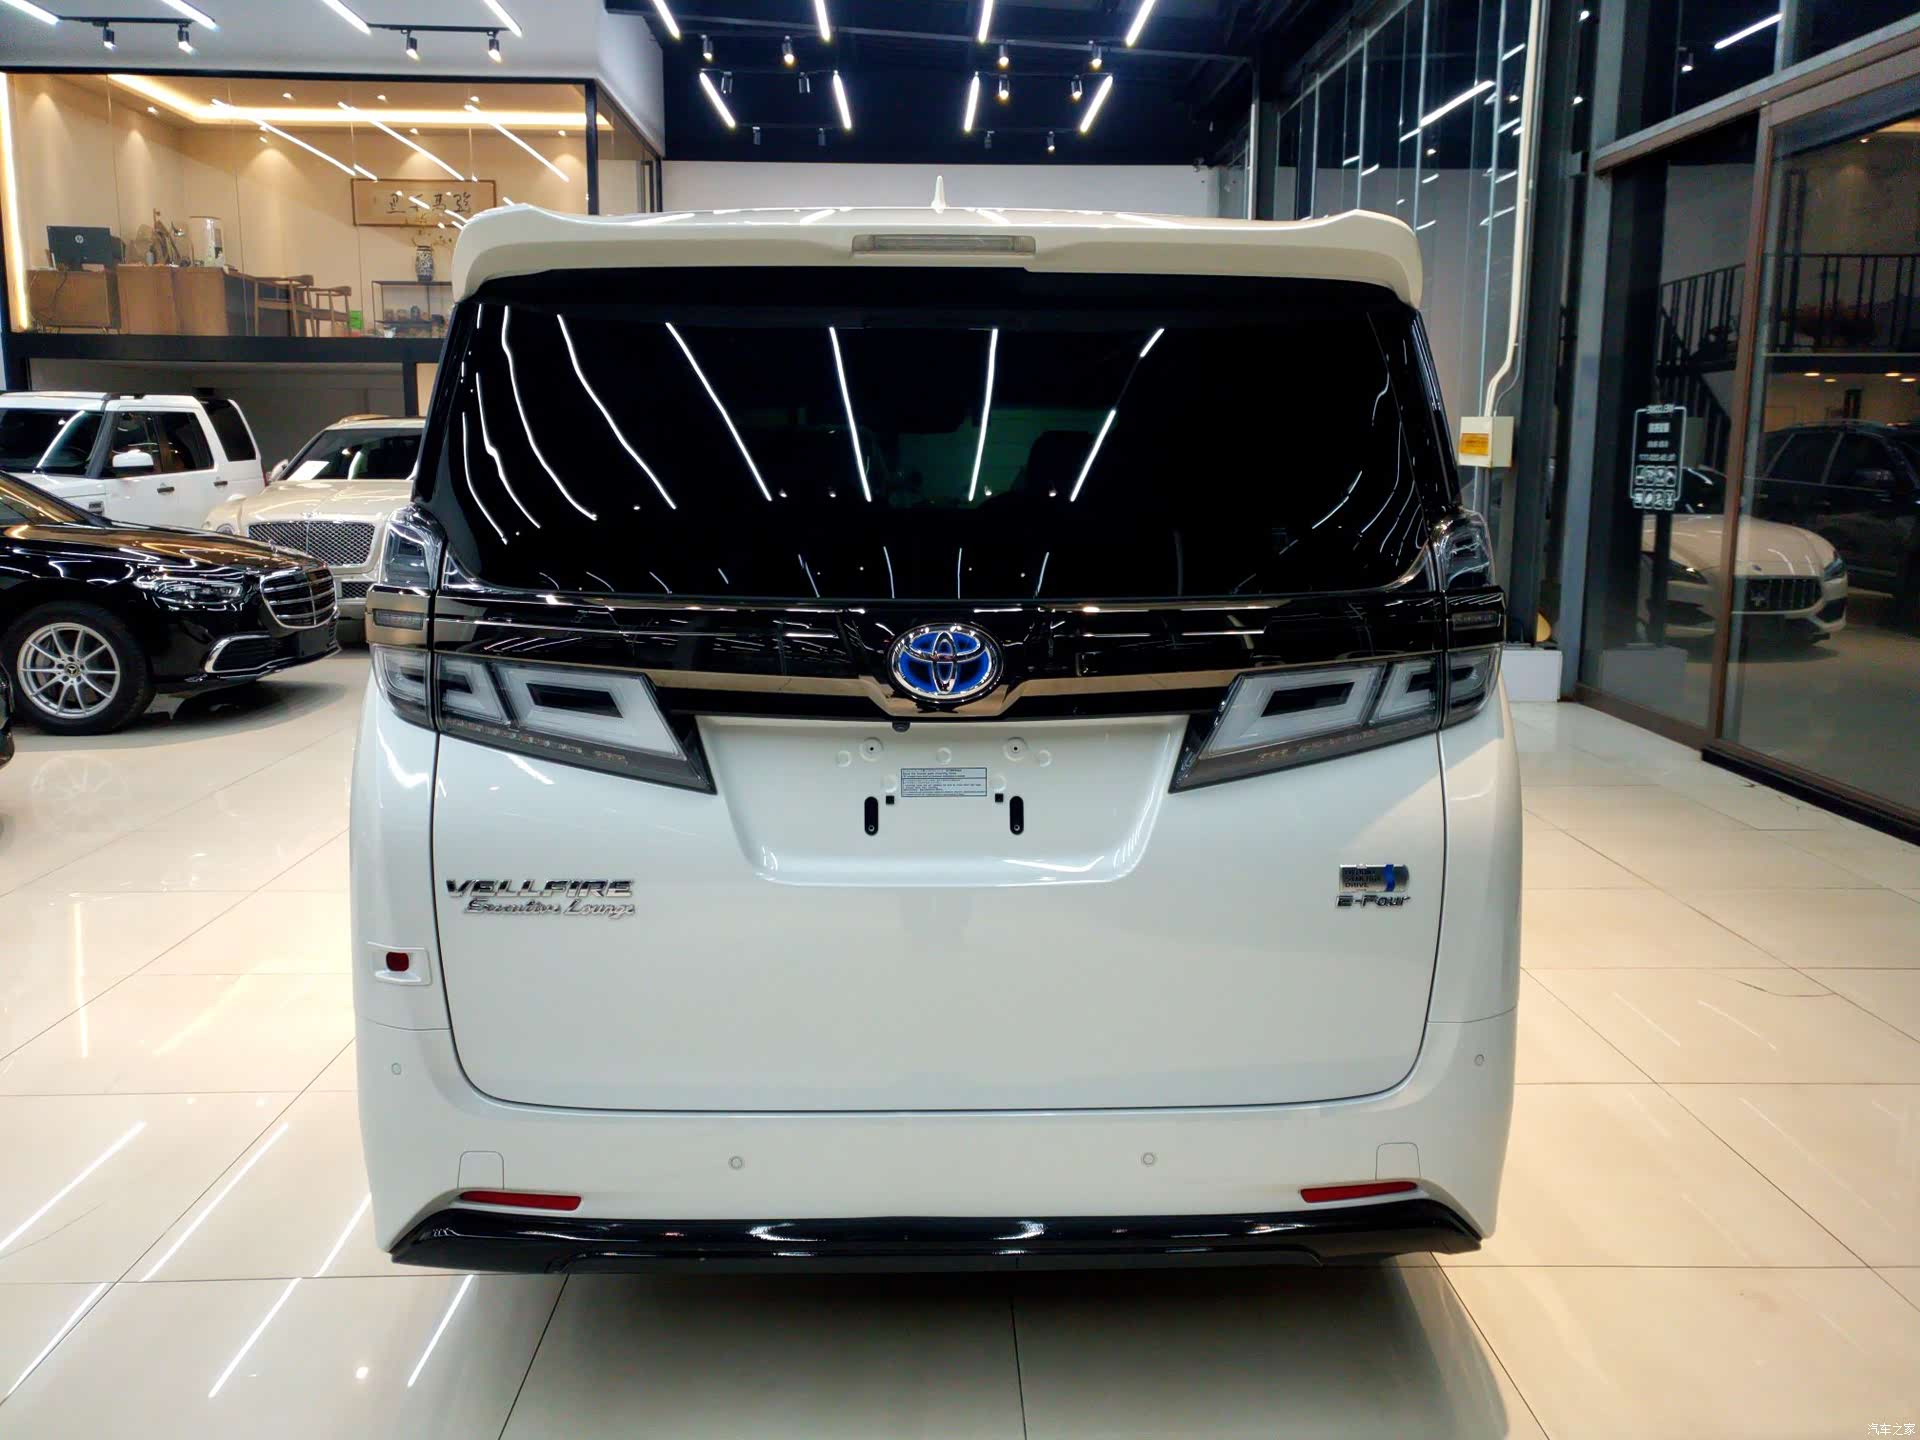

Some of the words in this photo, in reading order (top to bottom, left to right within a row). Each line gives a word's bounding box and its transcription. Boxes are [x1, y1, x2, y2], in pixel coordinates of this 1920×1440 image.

[445, 878, 635, 898] VELLFIRE
[463, 897, 562, 916] Executive
[563, 898, 636, 919] Lounge
[1336, 895, 1411, 907] E-Four
